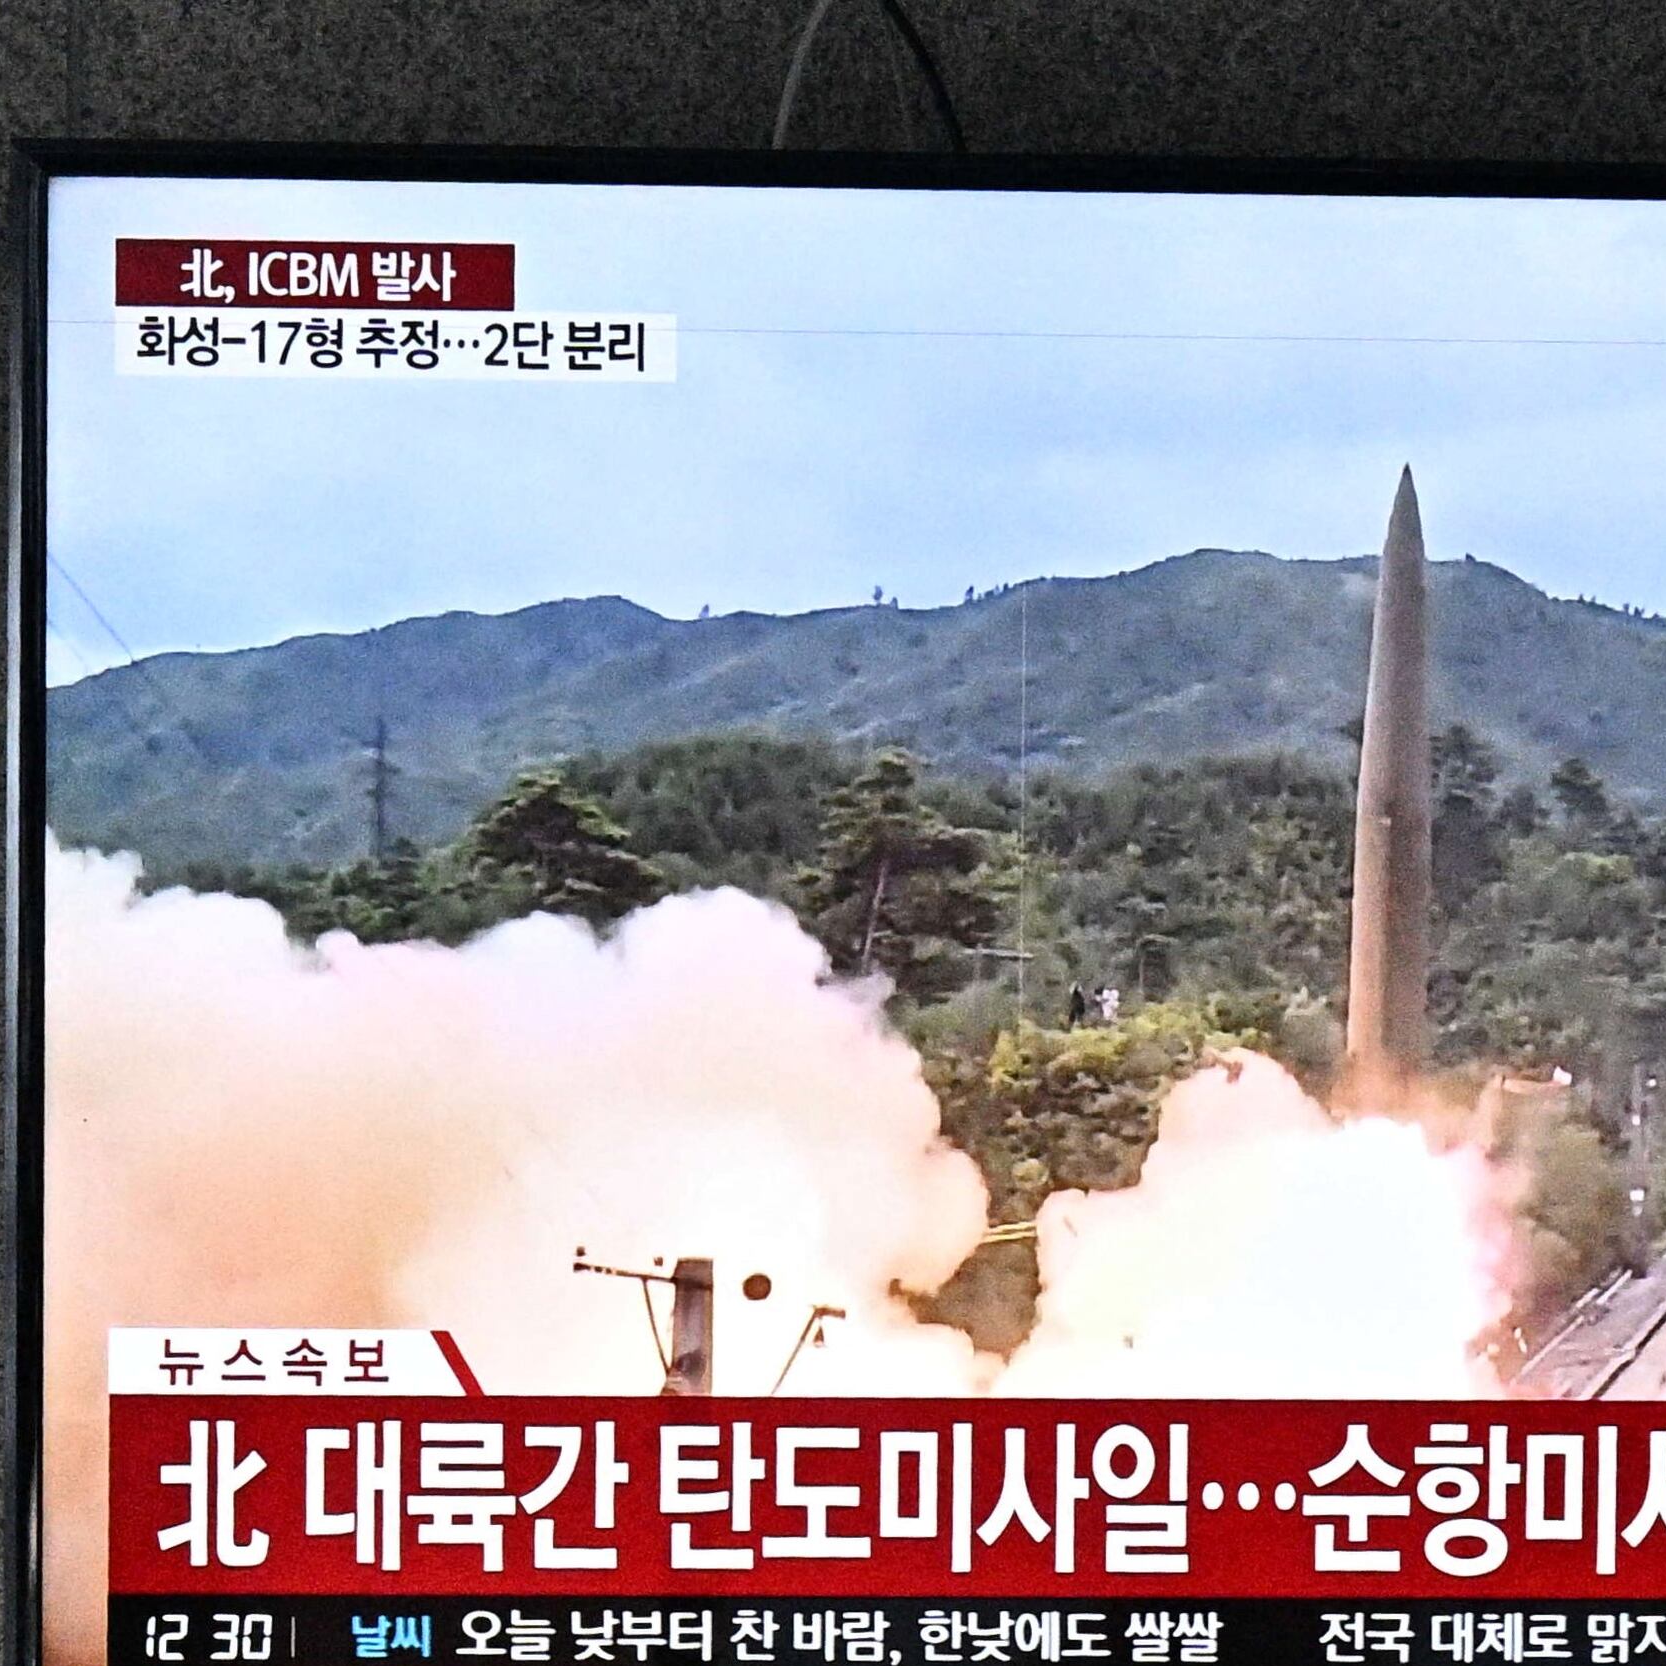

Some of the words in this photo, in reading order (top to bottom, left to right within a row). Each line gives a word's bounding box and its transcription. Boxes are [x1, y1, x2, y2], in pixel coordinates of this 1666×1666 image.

[247, 250, 361, 299] ICBM
[371, 250, 458, 303] 발사
[136, 315, 344, 369] 화성-17형
[563, 321, 645, 372] 분리
[159, 1338, 389, 1387] 뉴스속보
[157, 1420, 270, 1567] 北
[305, 1420, 629, 1572] 대륙간
[145, 1614, 189, 1661] 12
[210, 1613, 273, 1660] 30
[351, 1615, 431, 1658] 날씨
[455, 1609, 556, 1661] 오늘
[571, 1609, 713, 1662] 낮부터
[730, 1609, 780, 1661] 찬
[793, 1610, 902, 1666] 바람,
[918, 1609, 1112, 1663] 한낮에도
[1124, 1611, 1224, 1663] 쌀쌀
[1319, 1612, 1415, 1664] 전국
[1431, 1612, 1573, 1664] 대체로
